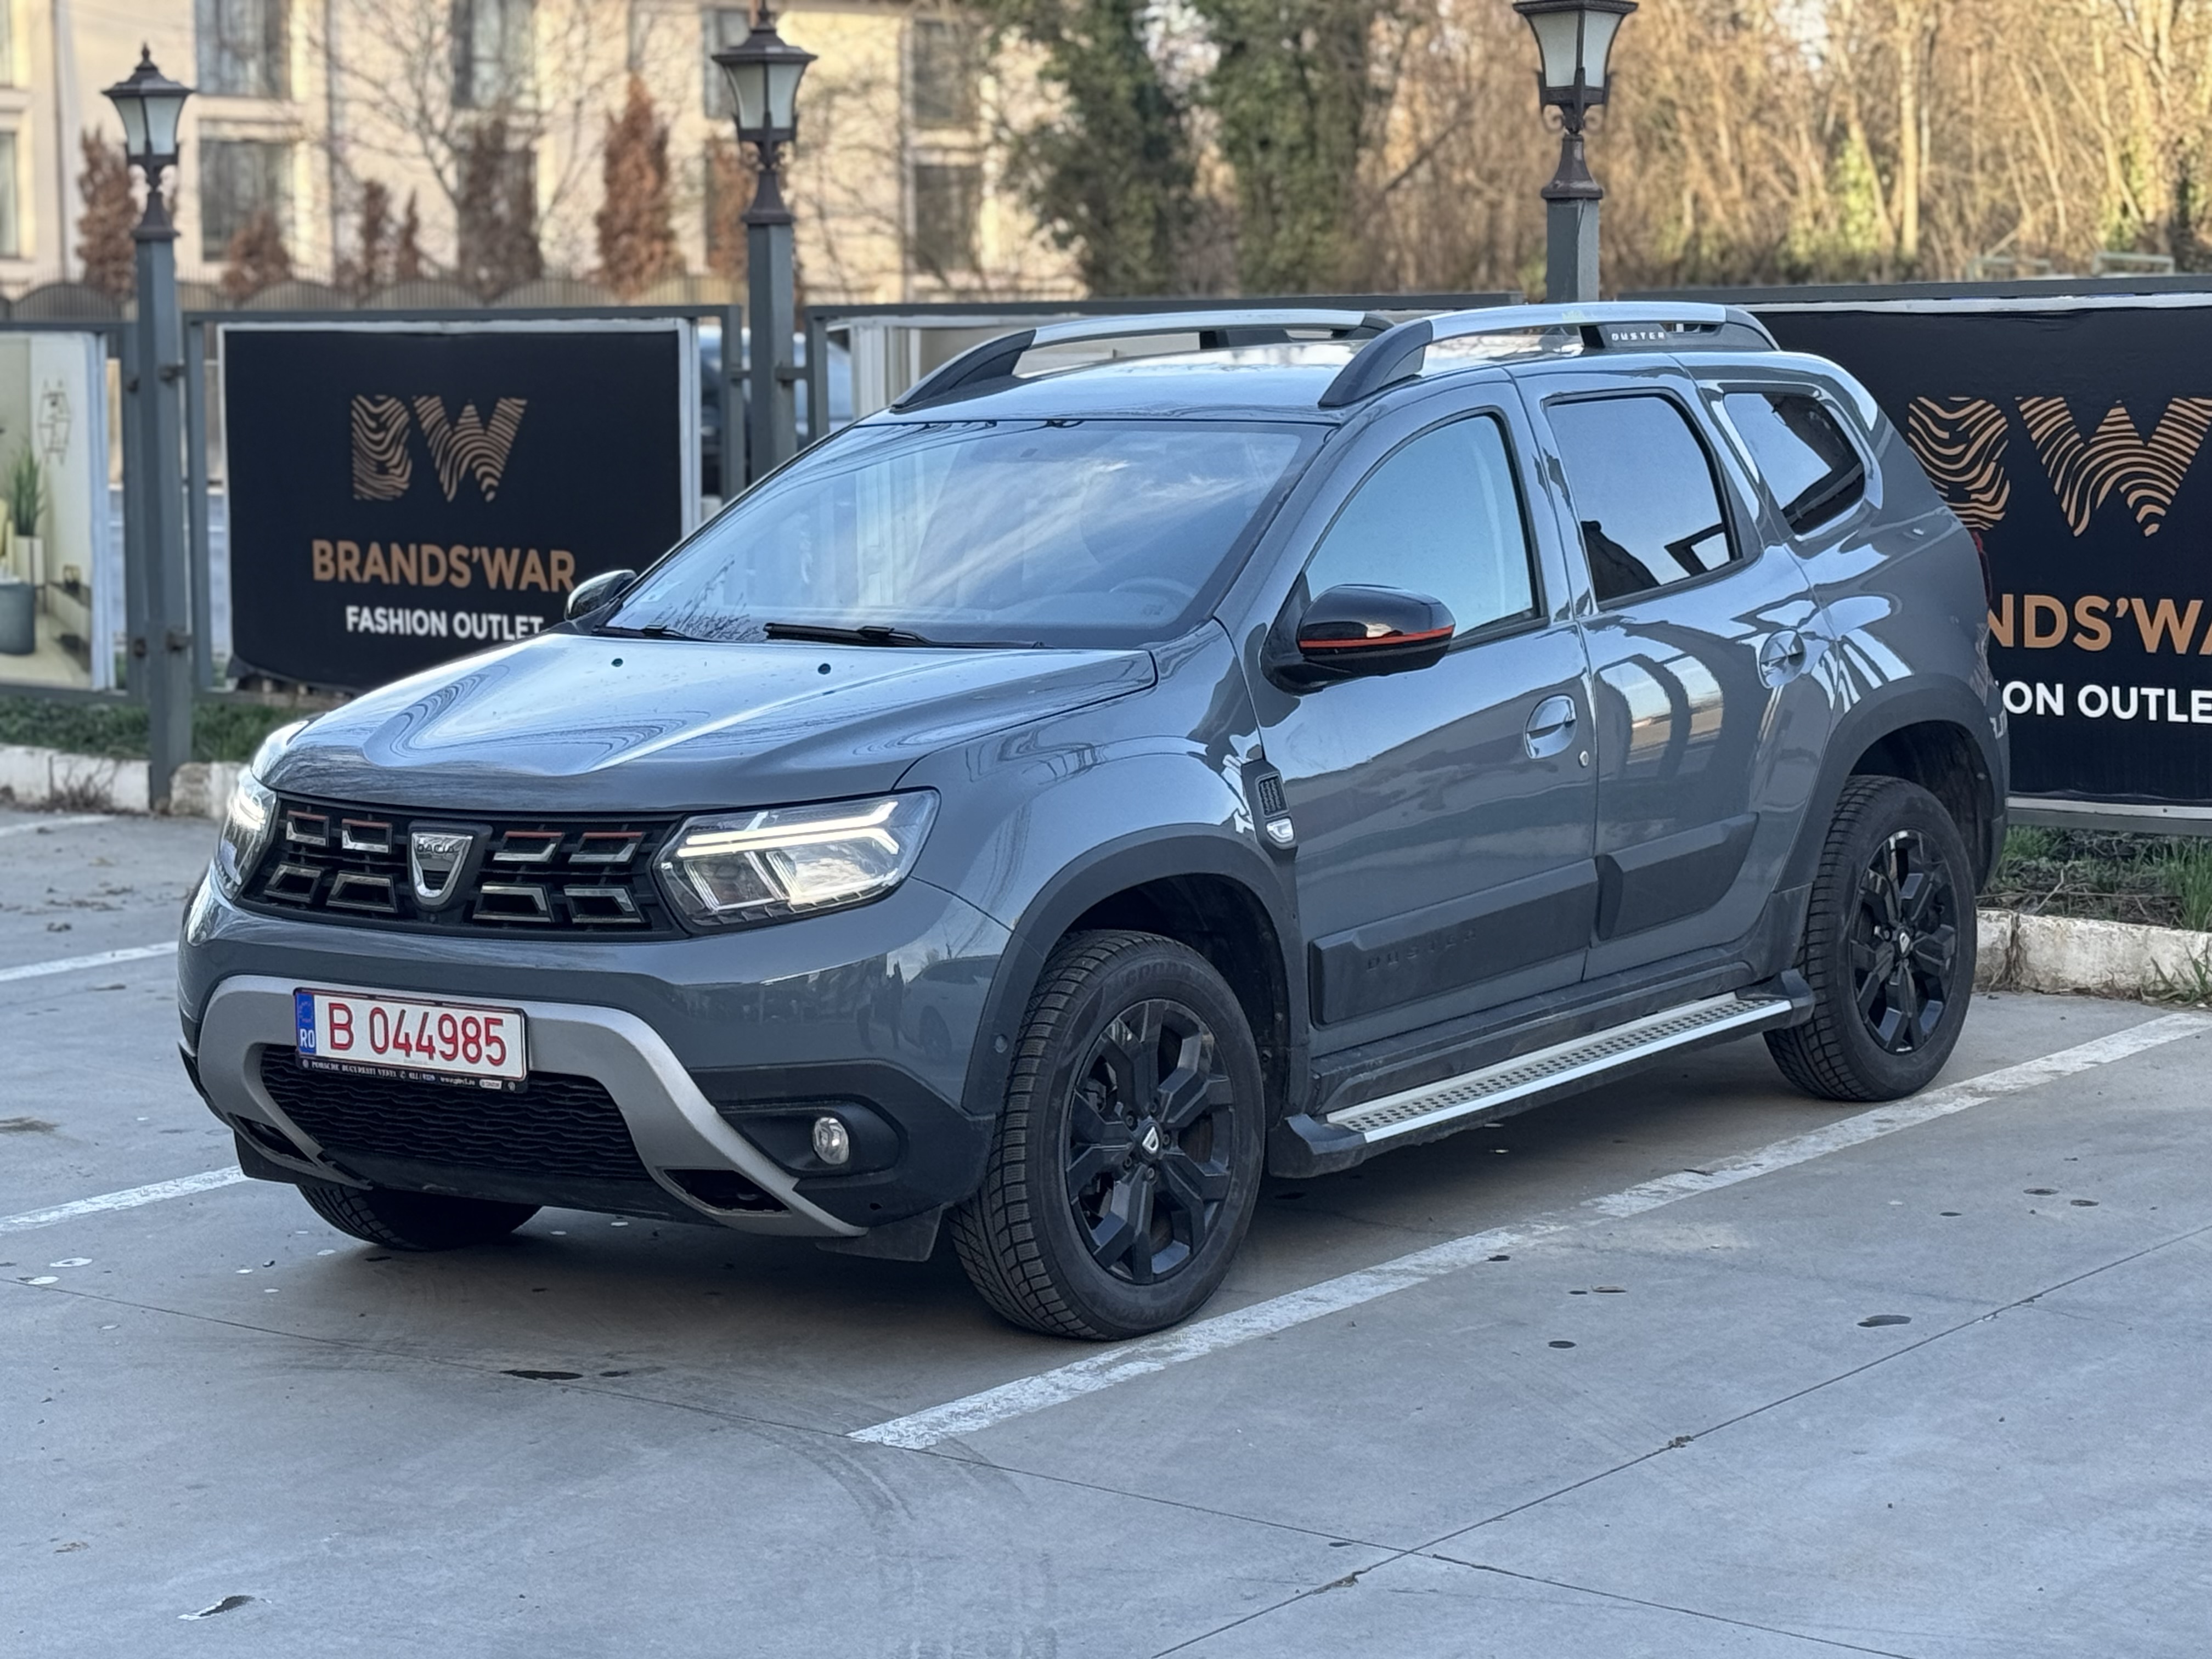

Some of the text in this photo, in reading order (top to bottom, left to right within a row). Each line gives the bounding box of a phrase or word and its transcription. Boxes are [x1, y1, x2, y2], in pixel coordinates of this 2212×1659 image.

[1611, 331, 1665, 341] DUSTER
[351, 394, 527, 502] BW
[312, 539, 575, 593] BRANDS'WAR
[346, 605, 544, 641] FASHION OUTLET
[1995, 680, 2064, 716] ON
[300, 1029, 315, 1048] RO
[329, 1003, 506, 1066] B 044985
